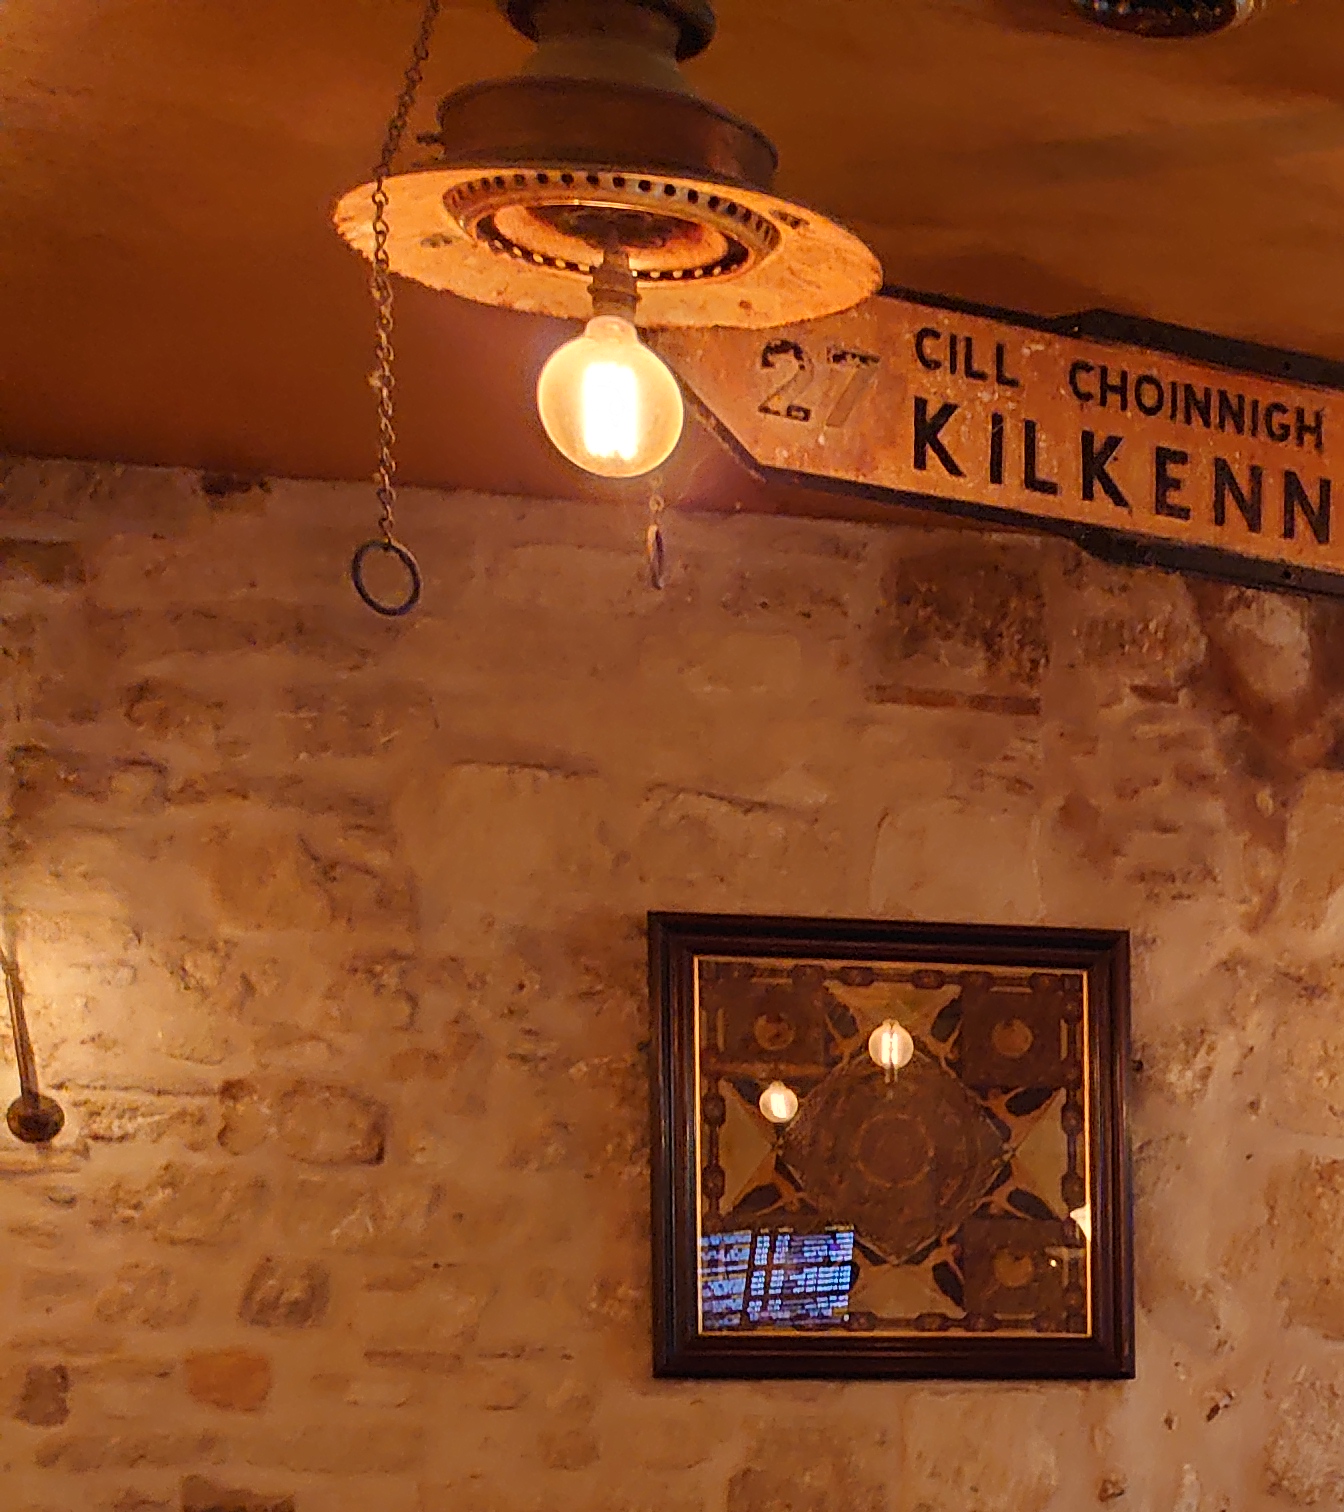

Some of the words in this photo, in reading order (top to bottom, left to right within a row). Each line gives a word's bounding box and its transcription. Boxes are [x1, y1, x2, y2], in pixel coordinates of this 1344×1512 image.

[758, 340, 880, 428] 27
[914, 327, 1020, 388] CILL
[1067, 358, 1325, 453] CHOINNIGH
